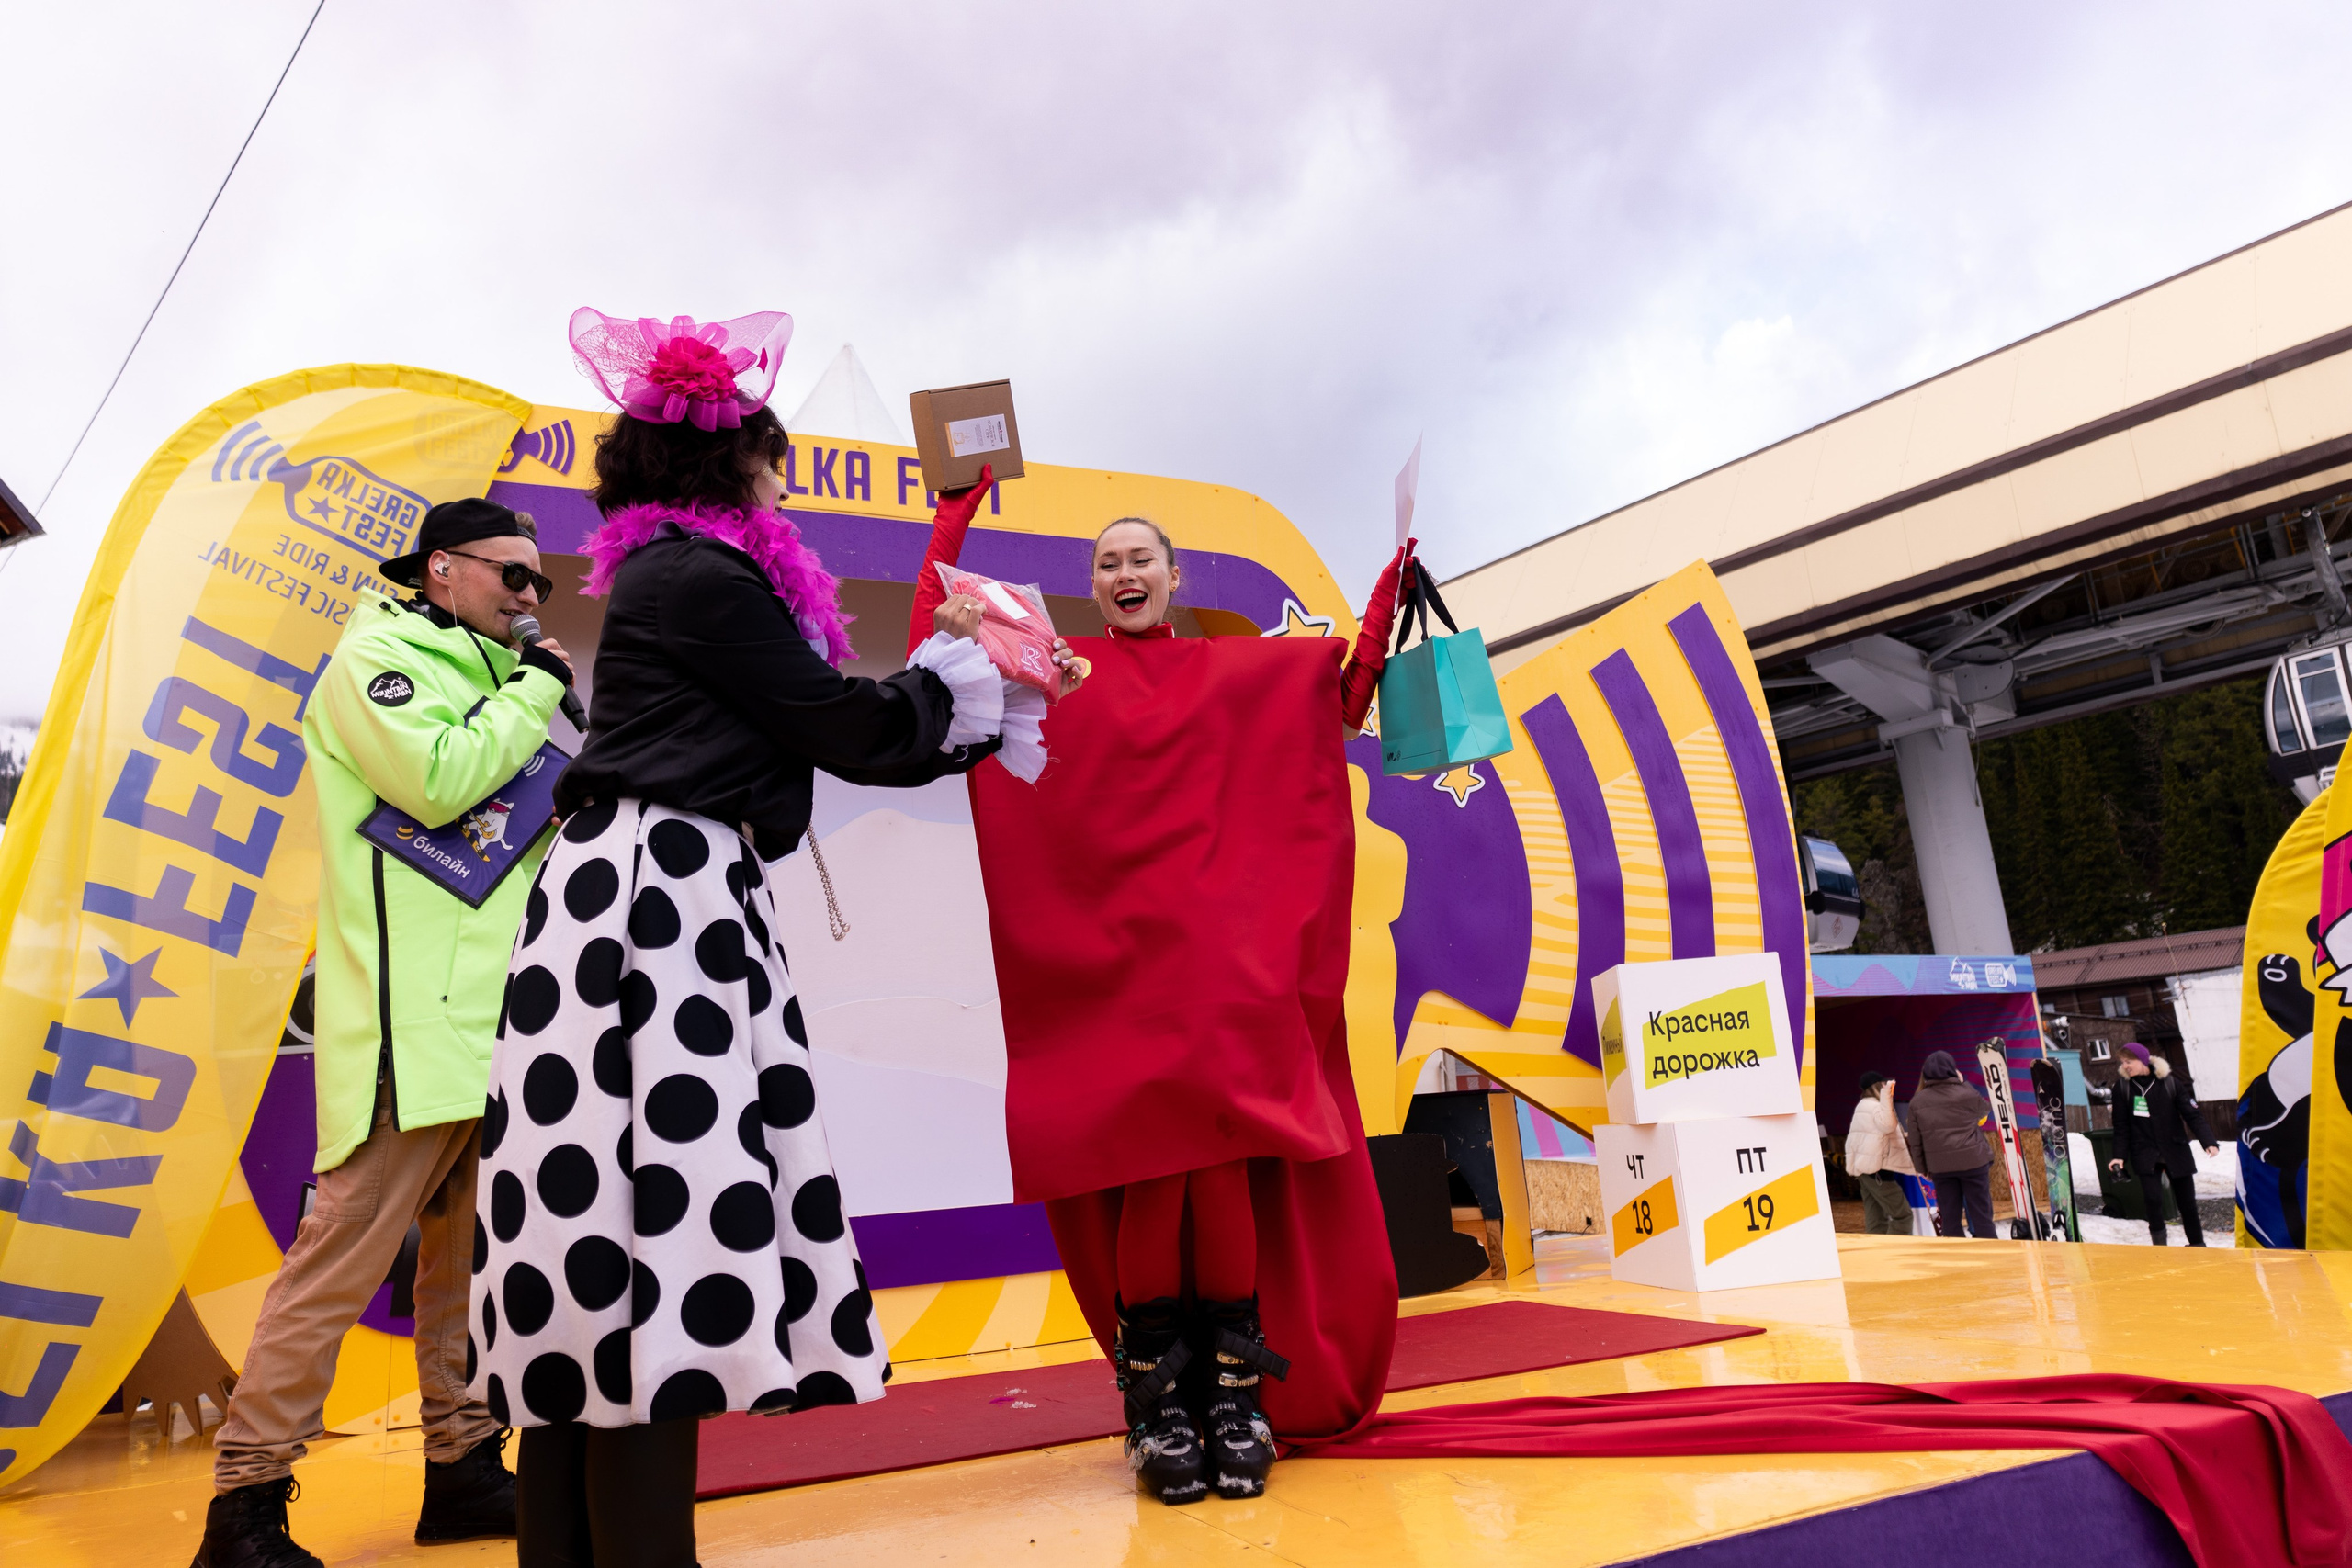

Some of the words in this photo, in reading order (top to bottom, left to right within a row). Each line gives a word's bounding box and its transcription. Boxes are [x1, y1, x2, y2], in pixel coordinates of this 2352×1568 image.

[786, 445, 871, 502] LKA
[413, 835, 471, 879] билайн
[1648, 1010, 1750, 1042] Красная
[1652, 1048, 1760, 1080] дорожка
[1989, 1063, 2014, 1144] HEAD
[1632, 1200, 1654, 1235] 18
[1743, 1193, 1775, 1232] 19
